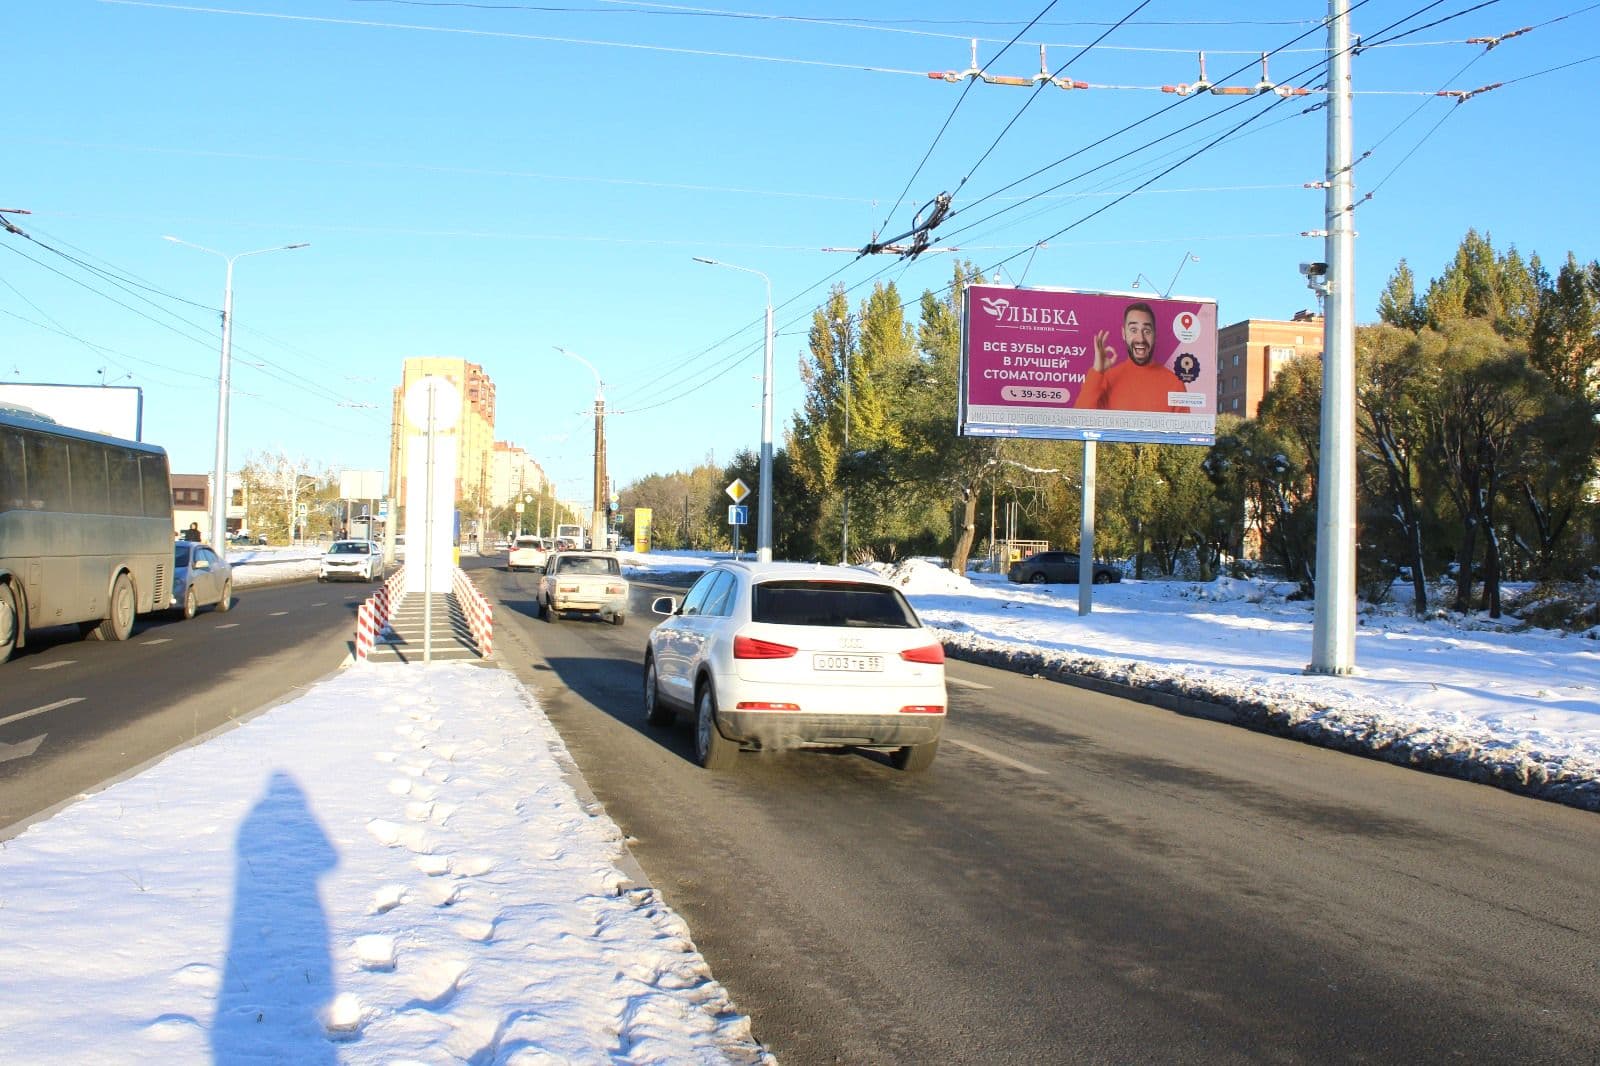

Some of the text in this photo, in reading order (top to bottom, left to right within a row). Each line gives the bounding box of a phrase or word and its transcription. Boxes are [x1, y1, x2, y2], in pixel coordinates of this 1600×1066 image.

[995, 304, 1080, 326] УЛЫБКА
[983, 341, 1087, 356] ВСЕ ЗУБЫ СРАЗУ
[1003, 356, 1011, 366] В
[983, 369, 1086, 383] СТОМАТОЛОГИИ
[1021, 390, 1062, 399] 39-36-26
